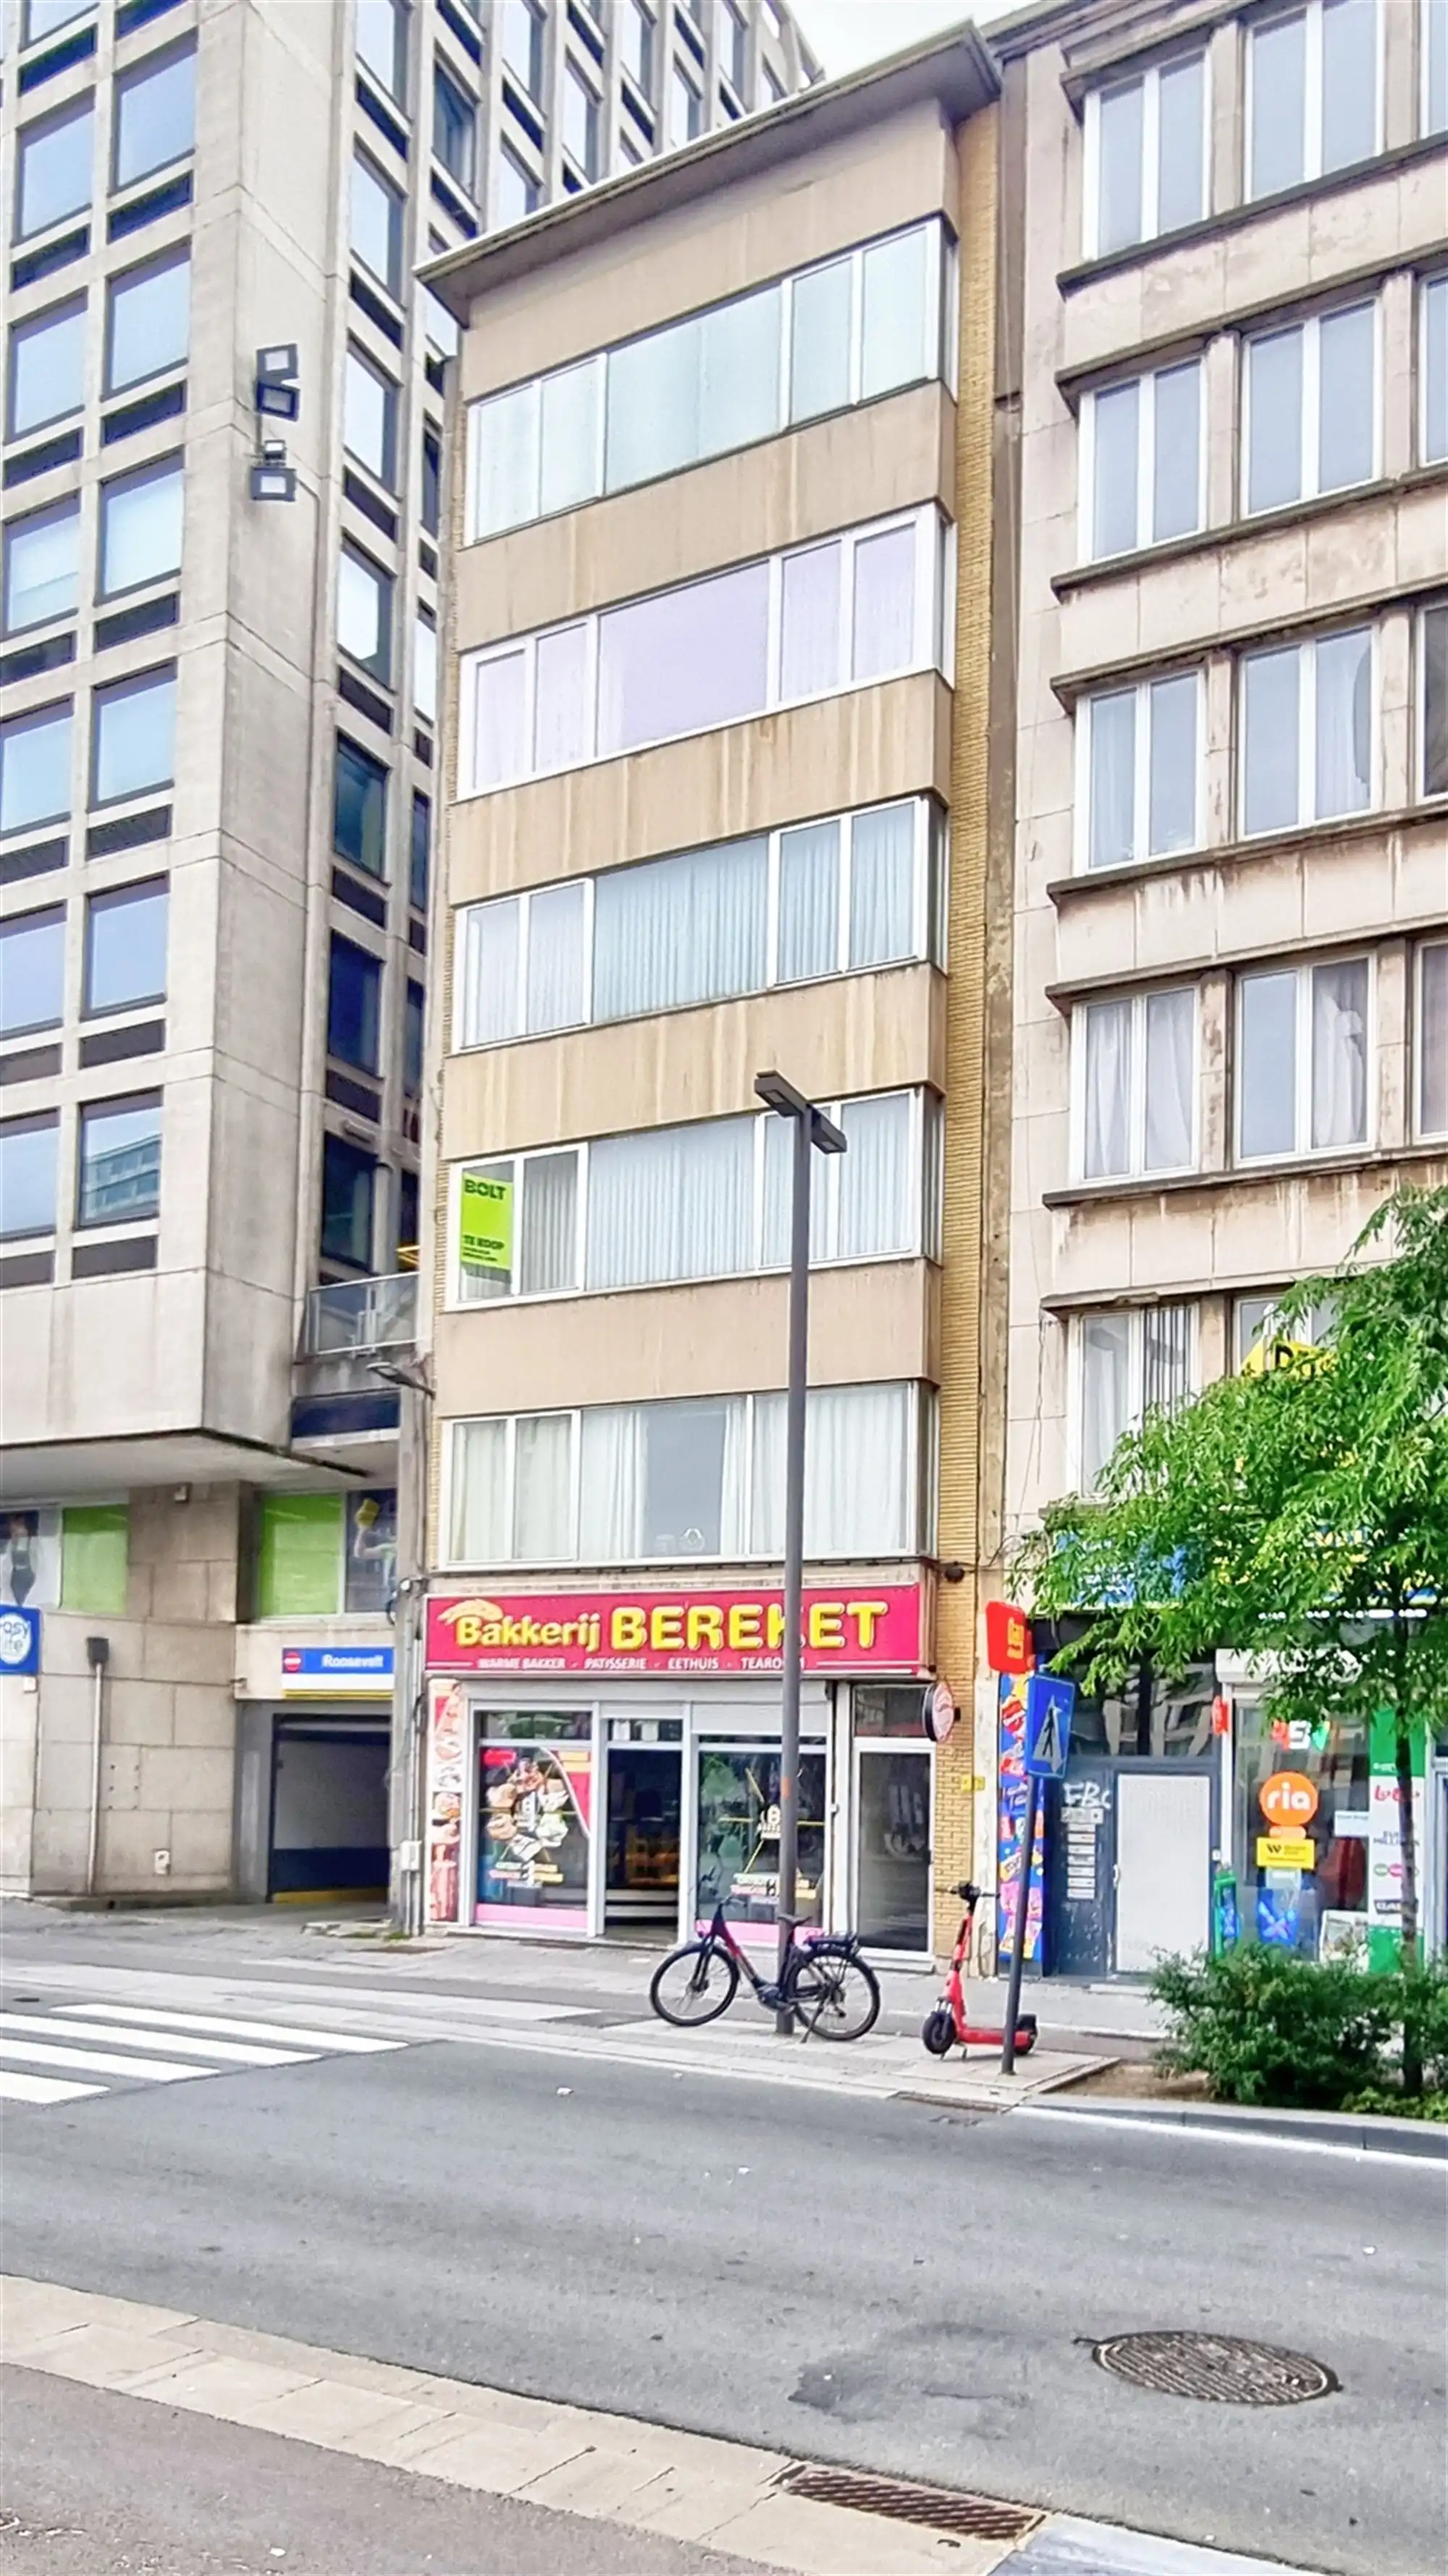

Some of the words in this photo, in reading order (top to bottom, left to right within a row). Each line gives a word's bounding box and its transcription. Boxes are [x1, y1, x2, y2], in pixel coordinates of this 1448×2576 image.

[465, 1179, 506, 1200] BOLT
[477, 1238, 505, 1250] KOOP
[0, 1620, 28, 1639] asy
[456, 1612, 600, 1652] Bakkerij
[584, 1657, 647, 1670] PATISSERIE
[668, 1656, 718, 1670] EETHUIS
[741, 1657, 804, 1670] TEARO
[1268, 1782, 1310, 1810] ria
